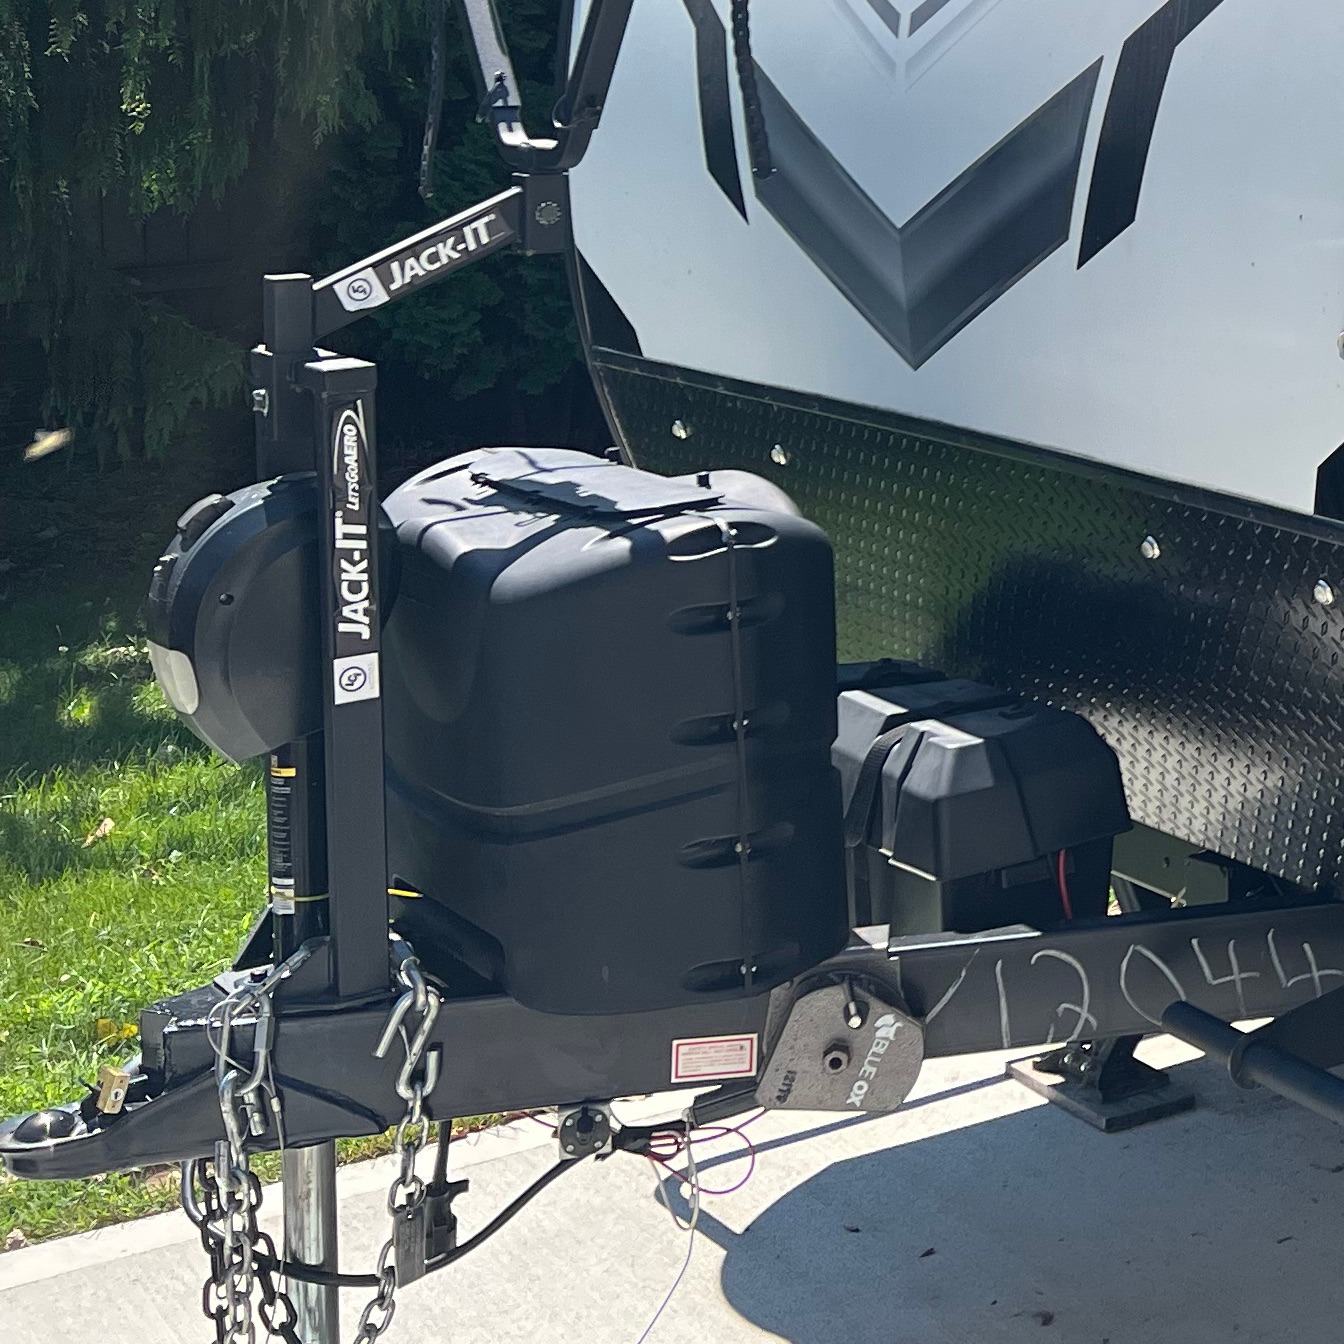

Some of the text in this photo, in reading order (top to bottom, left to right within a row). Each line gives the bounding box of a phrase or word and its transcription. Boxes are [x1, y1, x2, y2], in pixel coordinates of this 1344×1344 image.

[388, 213, 496, 291] JACK-IT
[334, 510, 371, 640] JACK-IT
[845, 1038, 890, 1107] BLUE OX
